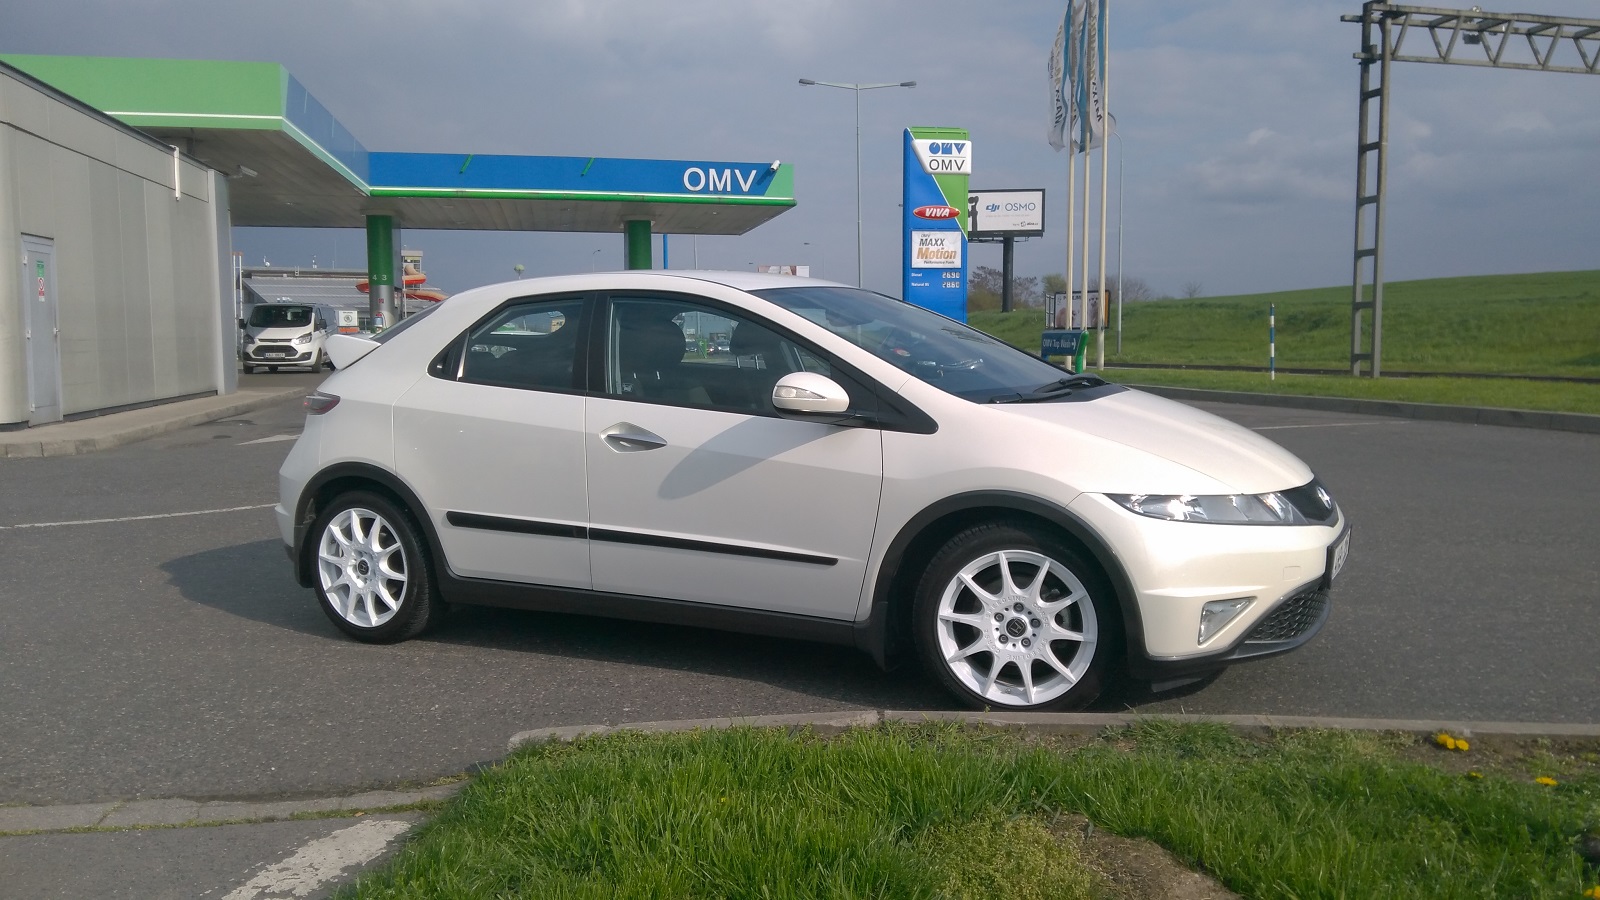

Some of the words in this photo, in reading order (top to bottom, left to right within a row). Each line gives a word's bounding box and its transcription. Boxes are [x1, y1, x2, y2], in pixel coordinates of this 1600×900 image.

[929, 159, 965, 171] OMV
[683, 167, 757, 192] OMV
[1005, 203, 1036, 211] OSMO
[925, 208, 950, 217] VIVA
[919, 238, 945, 246] MAXX
[917, 247, 957, 259] Motion
